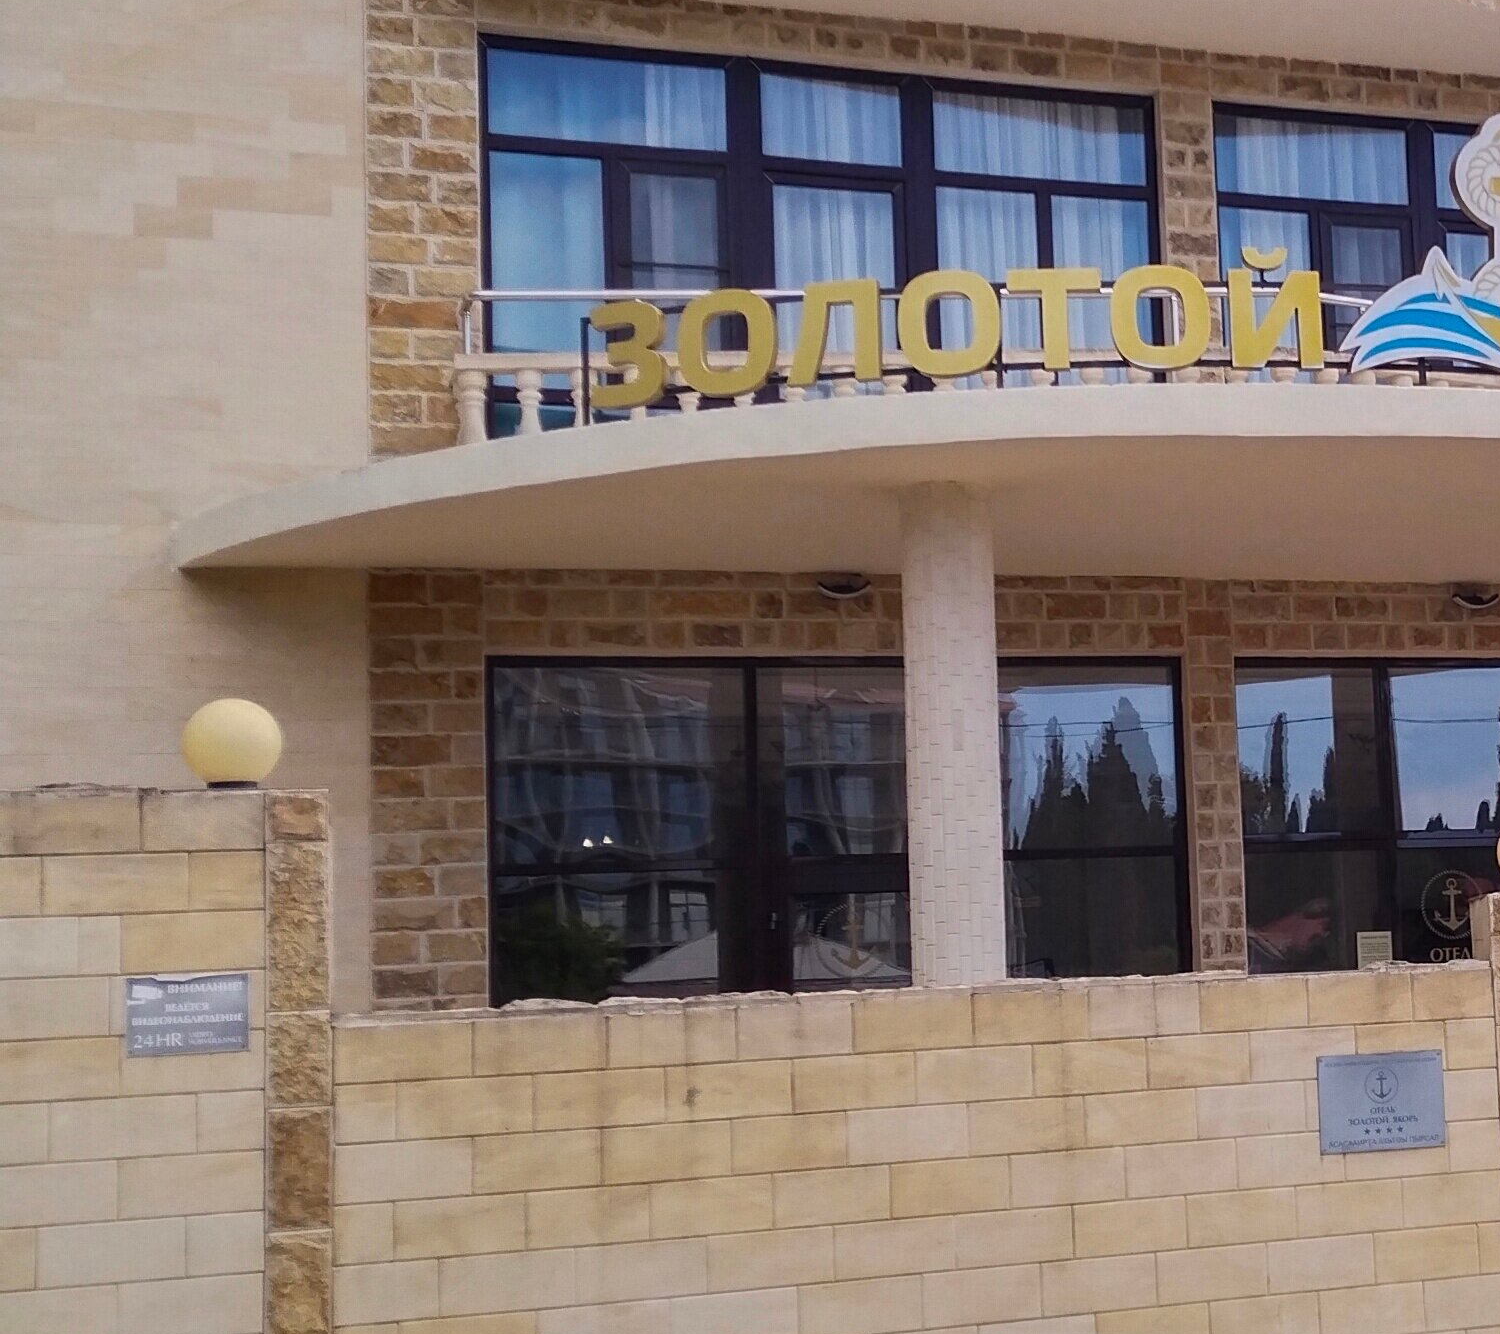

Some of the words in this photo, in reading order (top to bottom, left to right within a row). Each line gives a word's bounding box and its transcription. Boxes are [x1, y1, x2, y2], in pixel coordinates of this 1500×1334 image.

[588, 246, 1323, 410] ЗОЛОТОЙ
[1370, 1106, 1395, 1114] ОТЕЛЬ
[1348, 1115, 1389, 1126] ЗОЛОТОЙ
[1393, 1114, 1419, 1123] ЯКОРЬ
